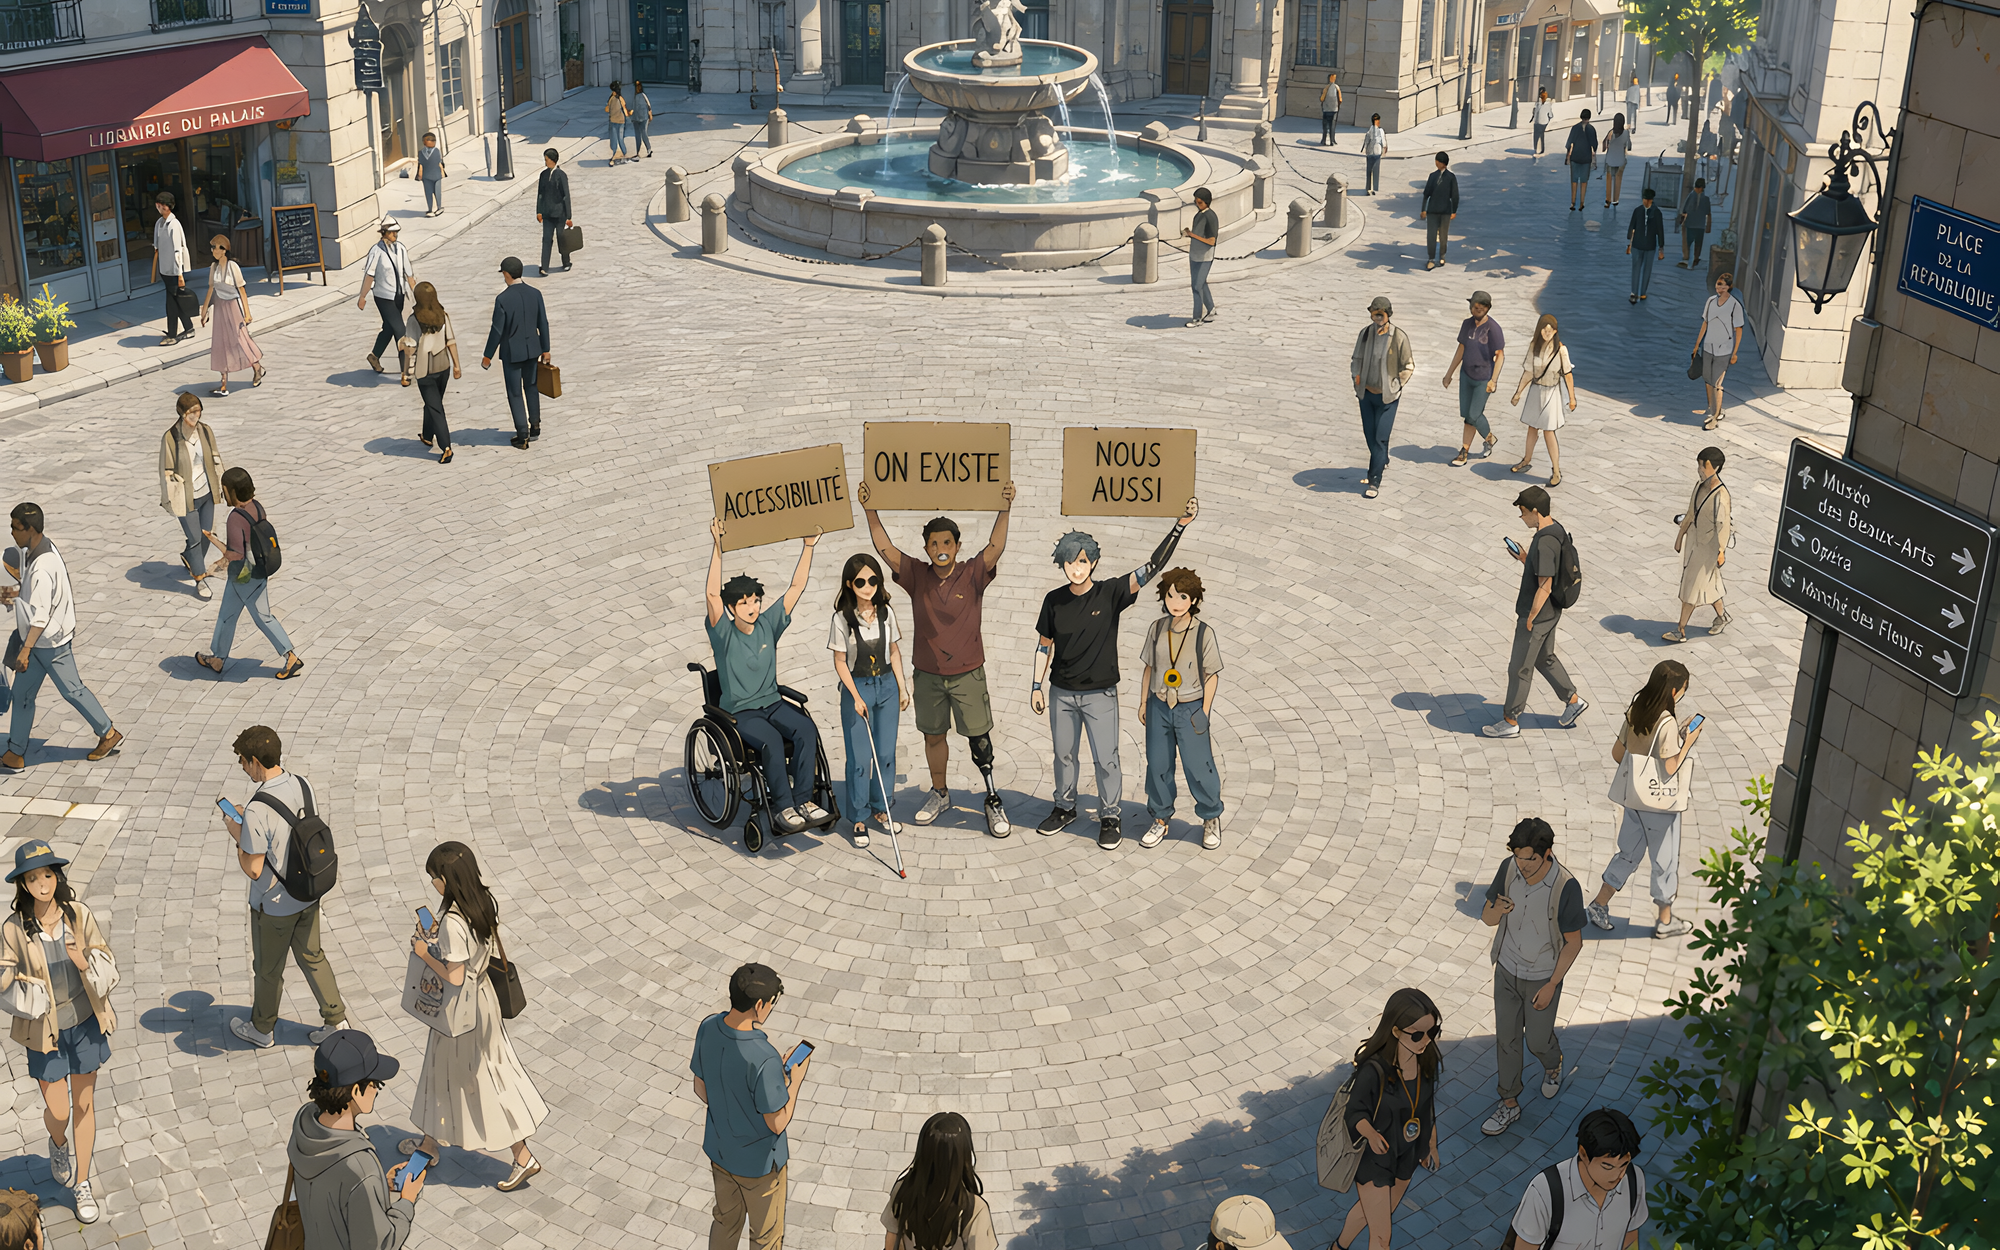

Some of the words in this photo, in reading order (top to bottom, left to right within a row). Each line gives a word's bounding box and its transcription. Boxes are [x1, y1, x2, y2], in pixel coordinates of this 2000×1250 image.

[181, 115, 202, 132] DU
[210, 106, 265, 127] PALAIS
[1936, 223, 1984, 255] PLACE
[1957, 259, 1972, 276] LA
[874, 451, 908, 482] ON
[920, 452, 1000, 483] EXISTE
[1096, 440, 1161, 467] NOUS
[1091, 475, 1162, 503] AUSSI
